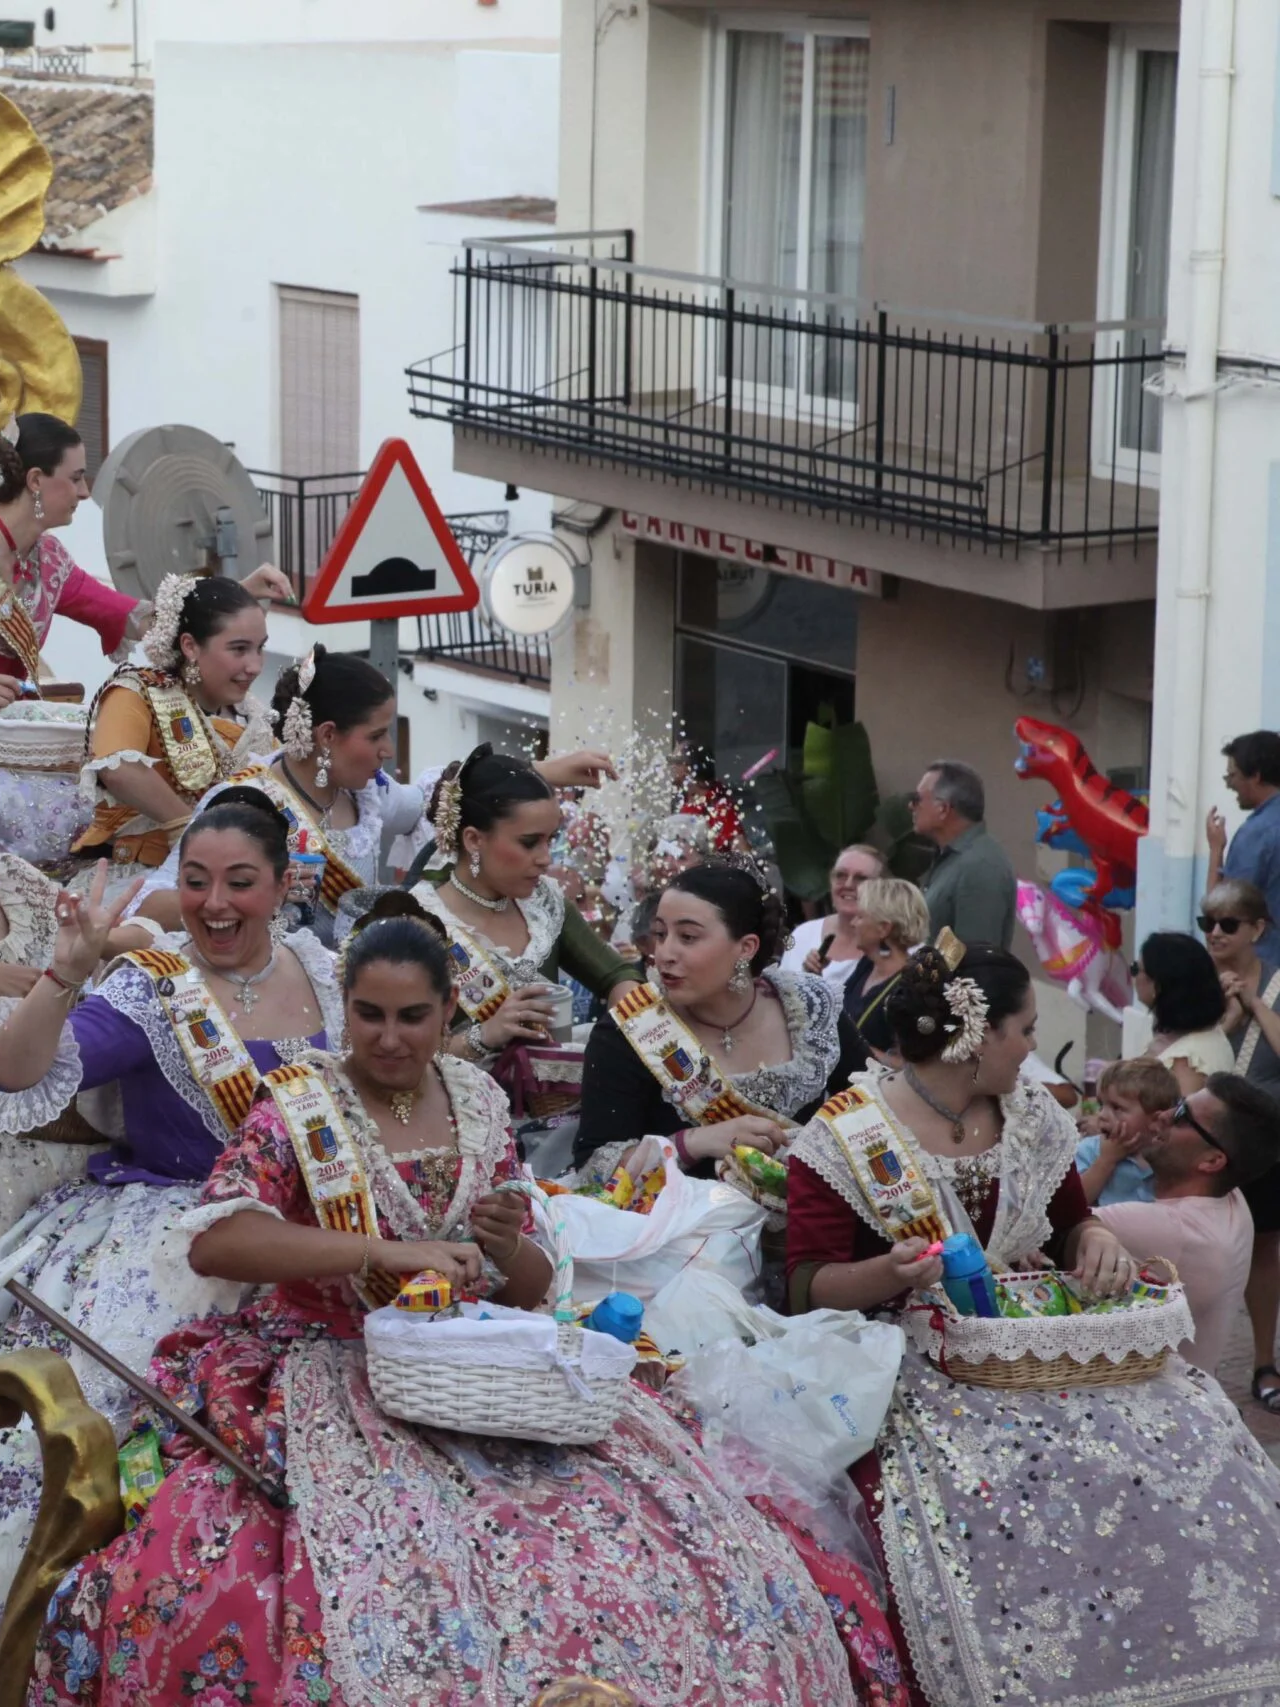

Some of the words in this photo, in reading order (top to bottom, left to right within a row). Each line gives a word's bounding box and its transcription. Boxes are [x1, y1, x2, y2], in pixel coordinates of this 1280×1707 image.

[513, 581, 557, 596] TURIA
[176, 743, 198, 754] 2018
[457, 966, 480, 986] 2018
[202, 1045, 230, 1063] 2018
[316, 1160, 345, 1178] 2018
[884, 1181, 912, 1200] 2018
